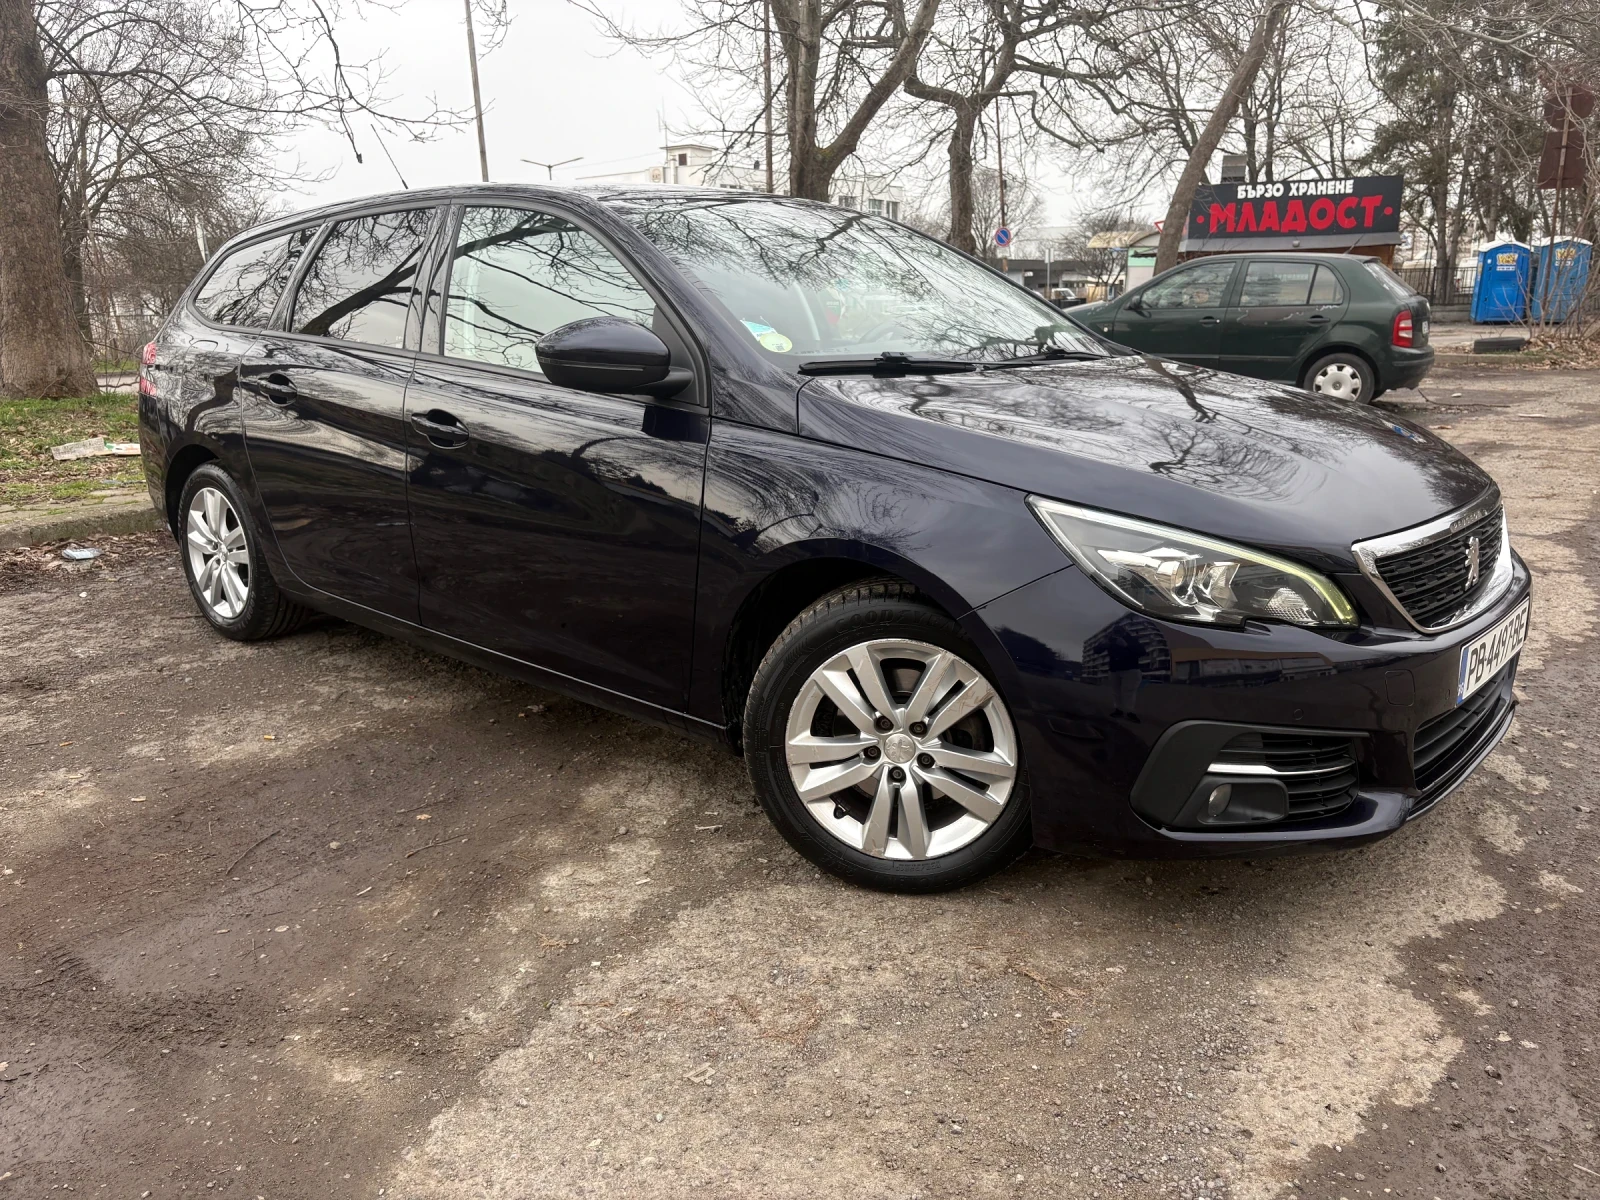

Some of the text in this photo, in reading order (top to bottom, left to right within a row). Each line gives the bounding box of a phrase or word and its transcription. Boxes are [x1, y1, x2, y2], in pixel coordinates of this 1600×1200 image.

[1237, 180, 1355, 199] БЪРЗО ХРАНЕНЕ
[1209, 195, 1383, 233] МЛАДОСТ
